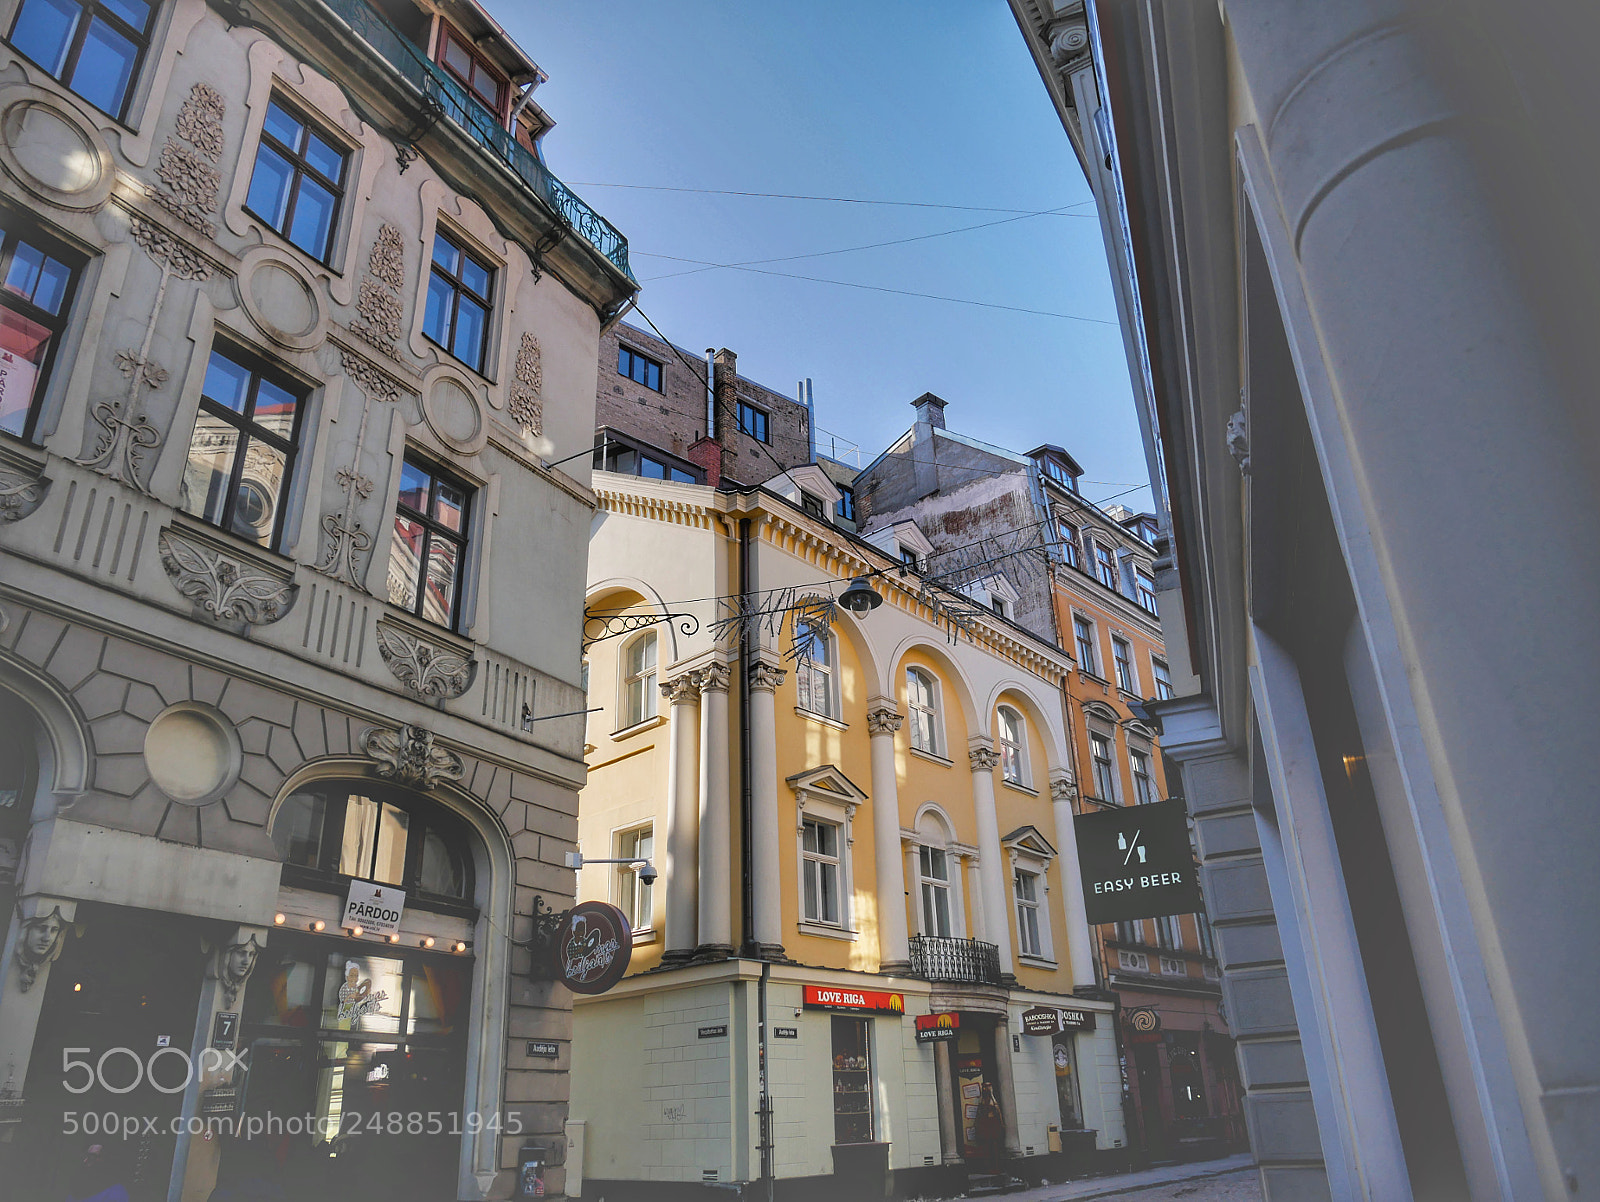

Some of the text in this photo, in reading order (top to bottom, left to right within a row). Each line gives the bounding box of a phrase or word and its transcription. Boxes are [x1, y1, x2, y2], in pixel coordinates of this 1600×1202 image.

[1094, 872, 1181, 894] EASY BEER
[348, 901, 399, 922] PĀRDOD
[817, 990, 866, 1005] LOVE RIGA
[1024, 1013, 1056, 1022] BABOOSHKA
[223, 1021, 231, 1035] 7
[920, 1029, 953, 1038] LOVE RIGA
